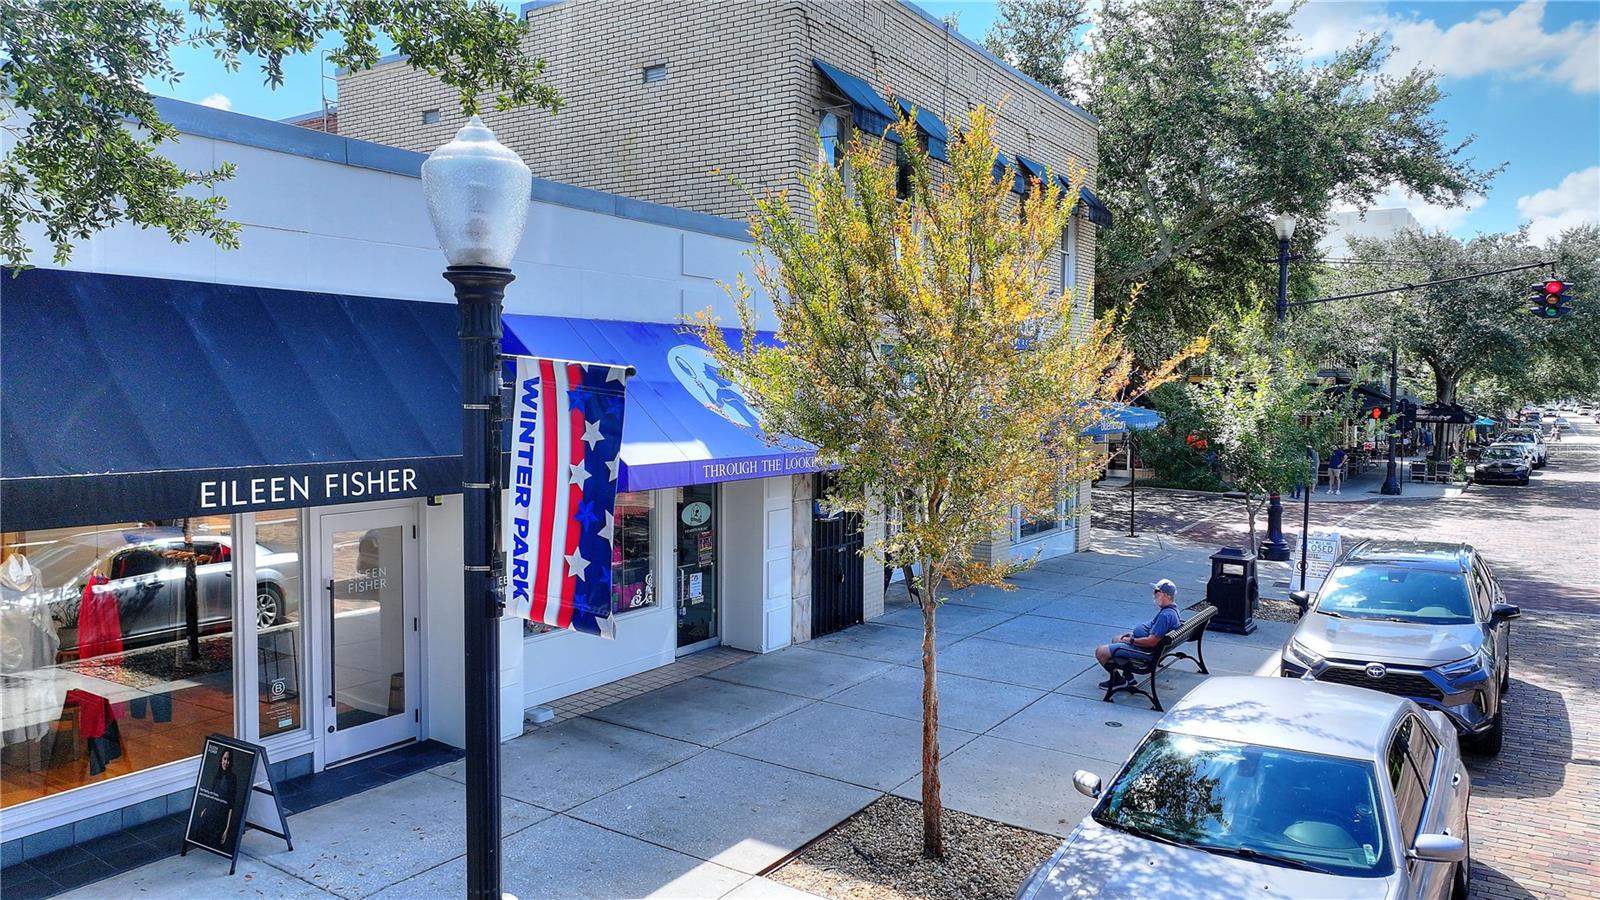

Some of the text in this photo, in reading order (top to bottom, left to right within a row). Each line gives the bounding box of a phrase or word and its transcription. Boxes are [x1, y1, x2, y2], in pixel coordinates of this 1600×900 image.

[702, 459, 757, 478] THROUGH
[761, 459, 782, 472] THE
[200, 468, 418, 508] EILEEN FISHER
[512, 376, 540, 603] WINTER PARK
[348, 579, 387, 593] FISHER
